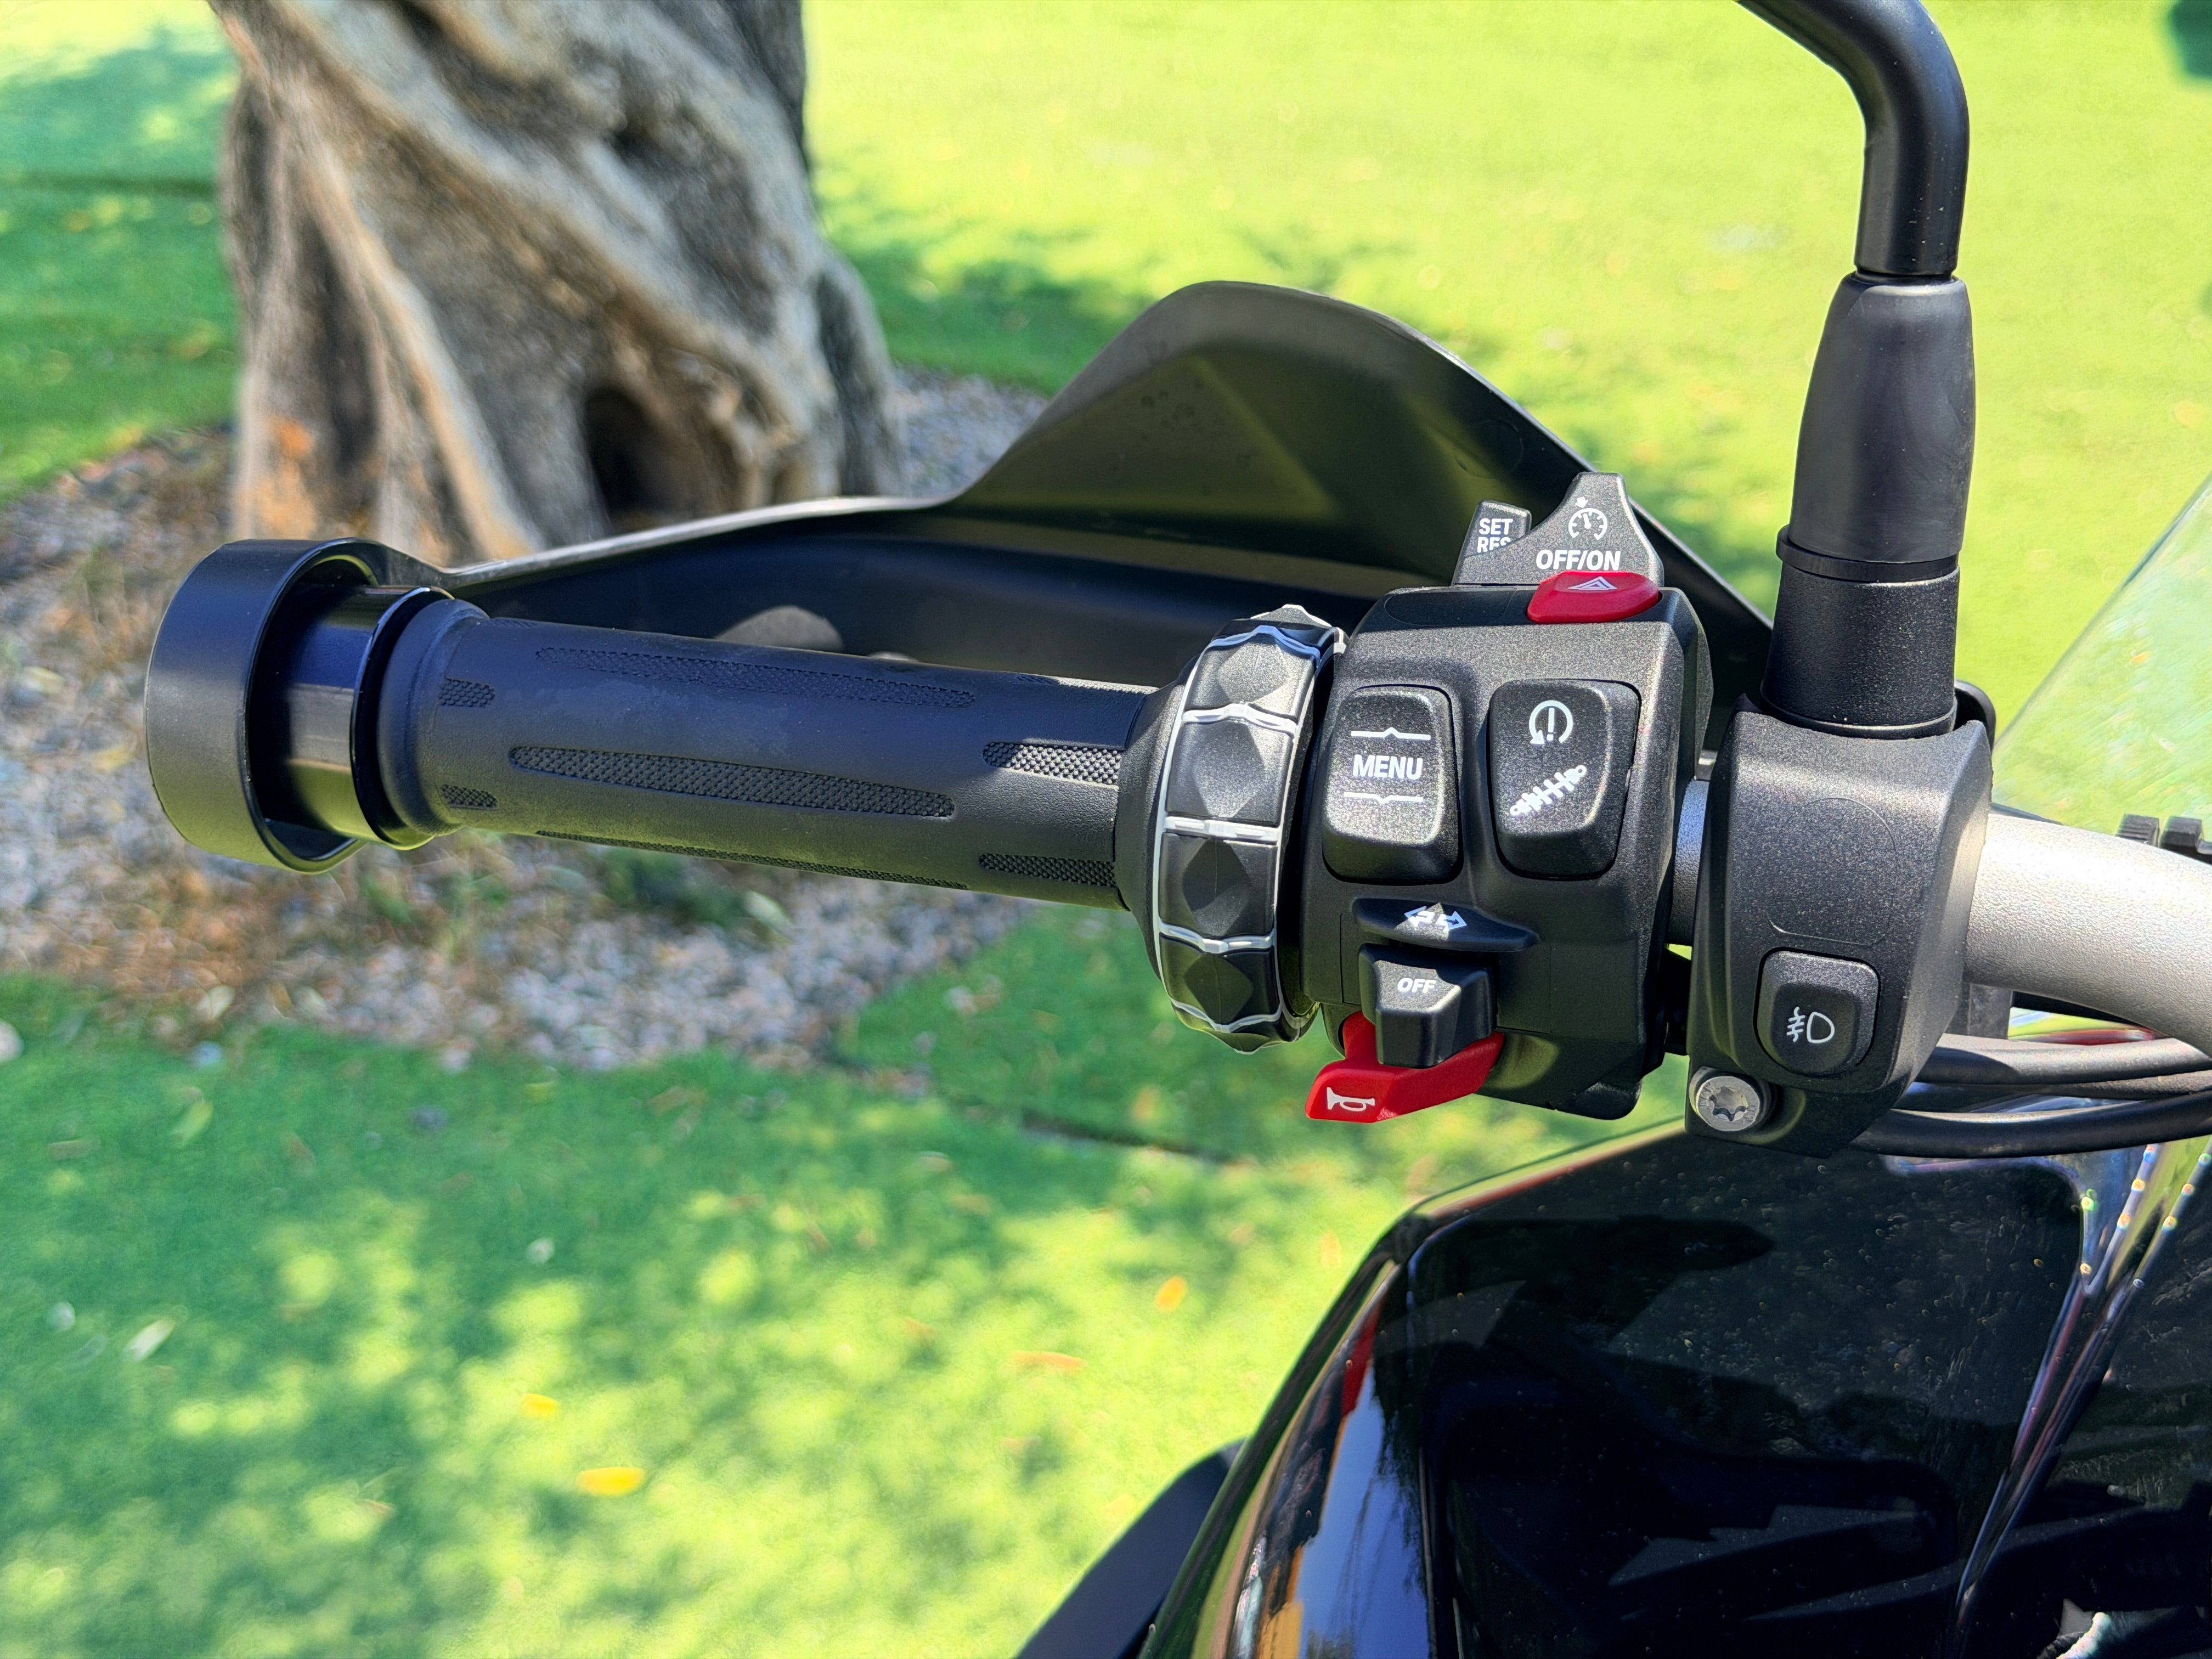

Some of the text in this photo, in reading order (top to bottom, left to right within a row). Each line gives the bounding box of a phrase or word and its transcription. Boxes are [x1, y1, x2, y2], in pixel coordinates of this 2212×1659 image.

[1479, 518, 1514, 535] SET
[1536, 549, 1621, 571] OFF/ON
[1352, 754, 1424, 780] MENU
[1397, 978, 1437, 994] OFF
